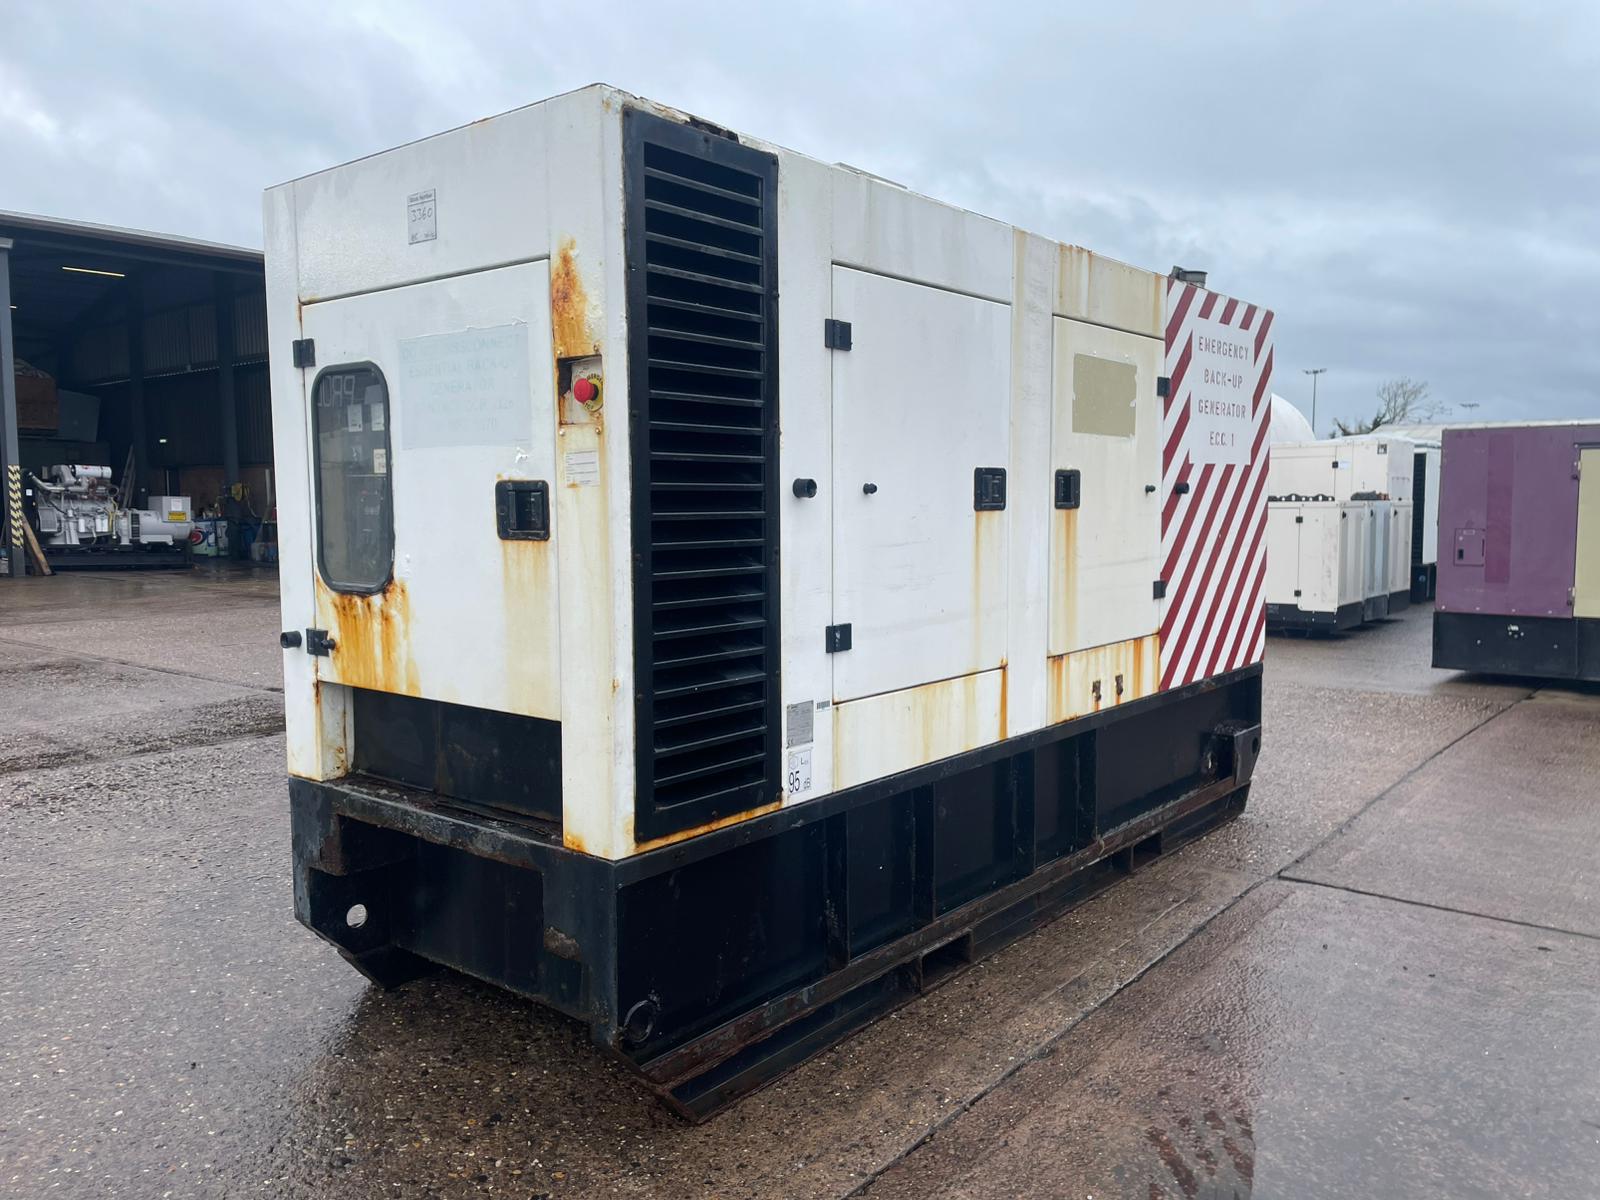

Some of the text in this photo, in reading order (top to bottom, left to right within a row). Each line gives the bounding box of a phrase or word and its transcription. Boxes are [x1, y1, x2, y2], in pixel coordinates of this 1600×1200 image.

[1198, 336, 1249, 361] EMERGENCY
[1204, 368, 1243, 389] BACK-UP
[1198, 399, 1246, 420] GENERATOR
[789, 770, 800, 793] 95
